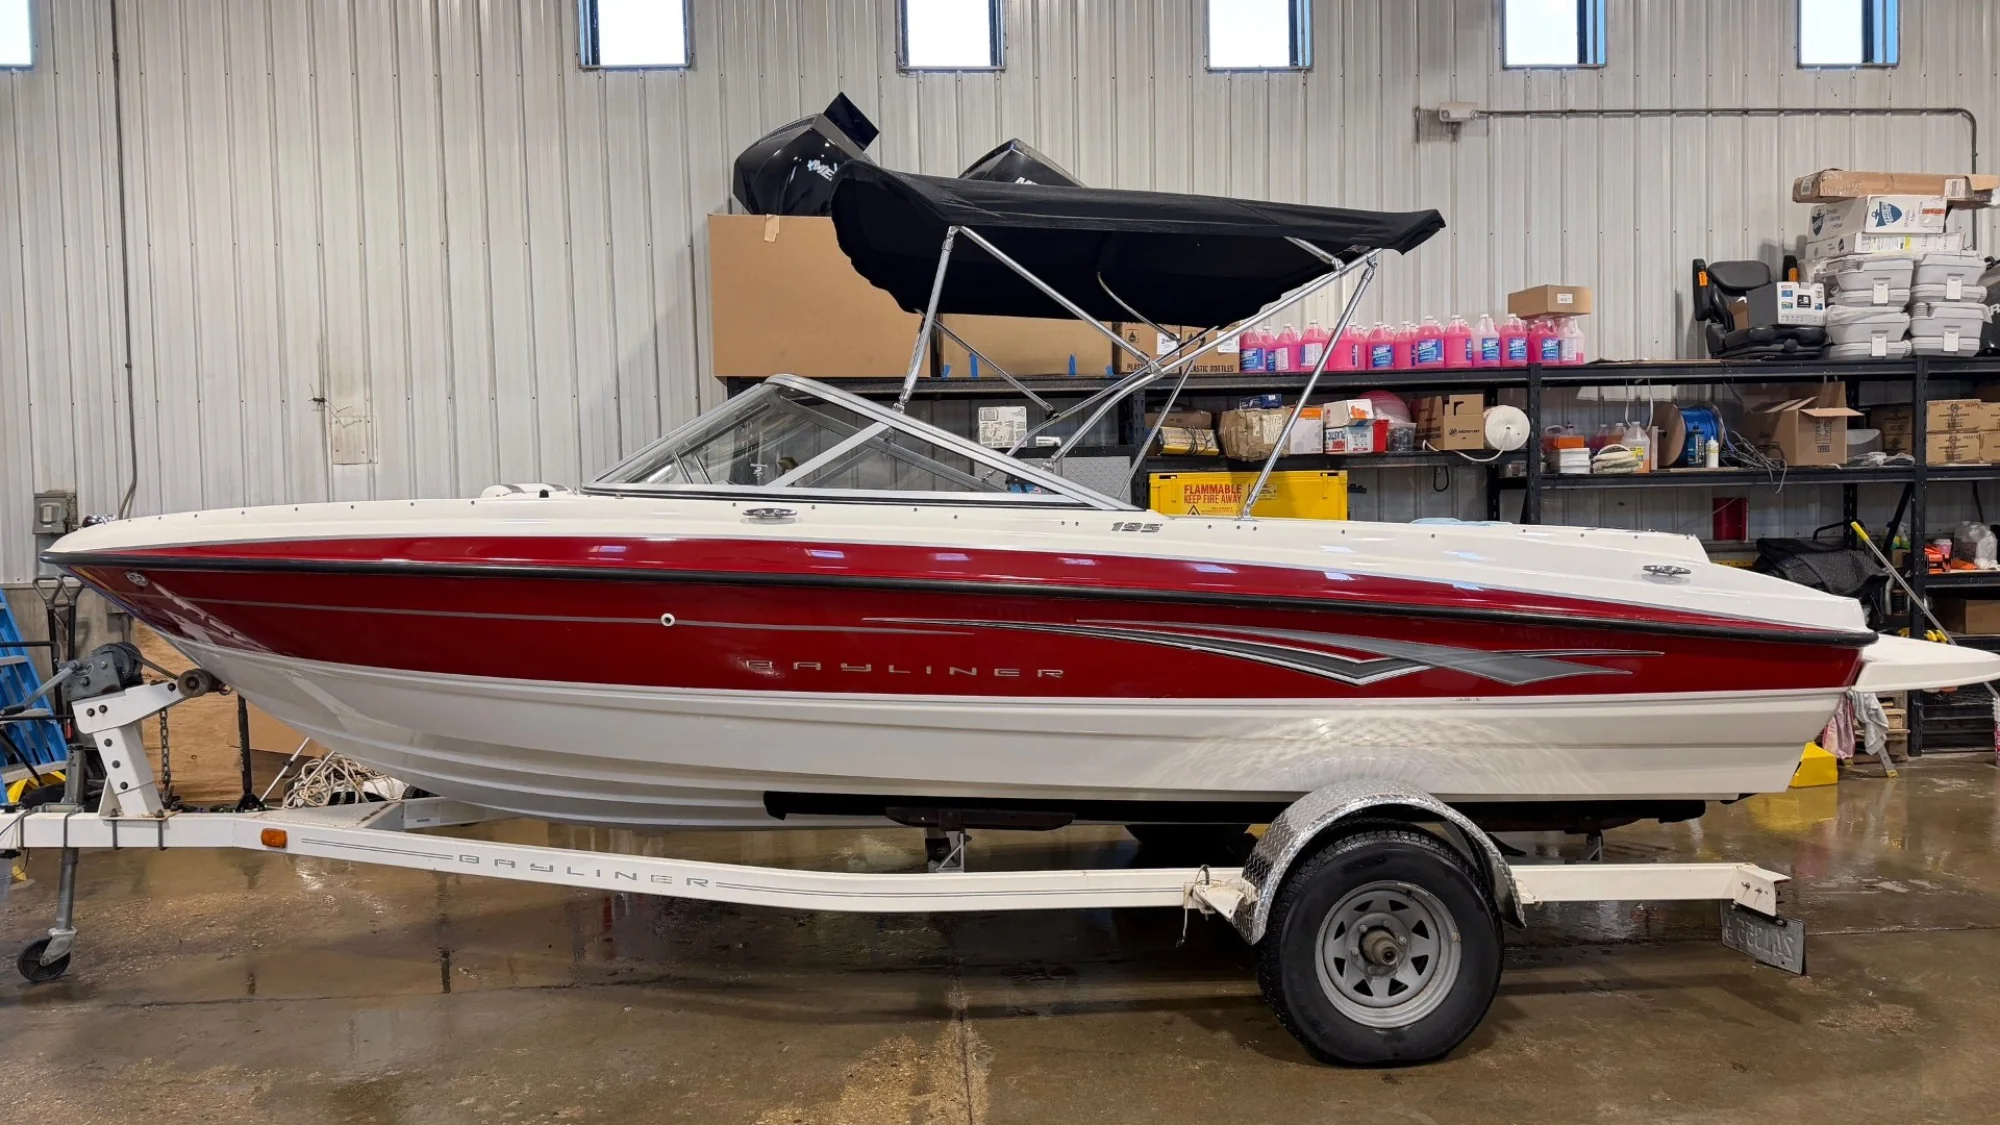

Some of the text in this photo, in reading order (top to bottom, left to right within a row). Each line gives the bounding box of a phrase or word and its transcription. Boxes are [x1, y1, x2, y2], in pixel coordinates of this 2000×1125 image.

[1210, 364, 1234, 373] BOTTLES
[1184, 484, 1242, 494] FLAMMABLE
[1184, 494, 1242, 504] KEEP FIRE AWAY
[1111, 521, 1163, 532] 195
[746, 659, 1064, 679] BAYLINER
[459, 854, 709, 888] BAYLINER
